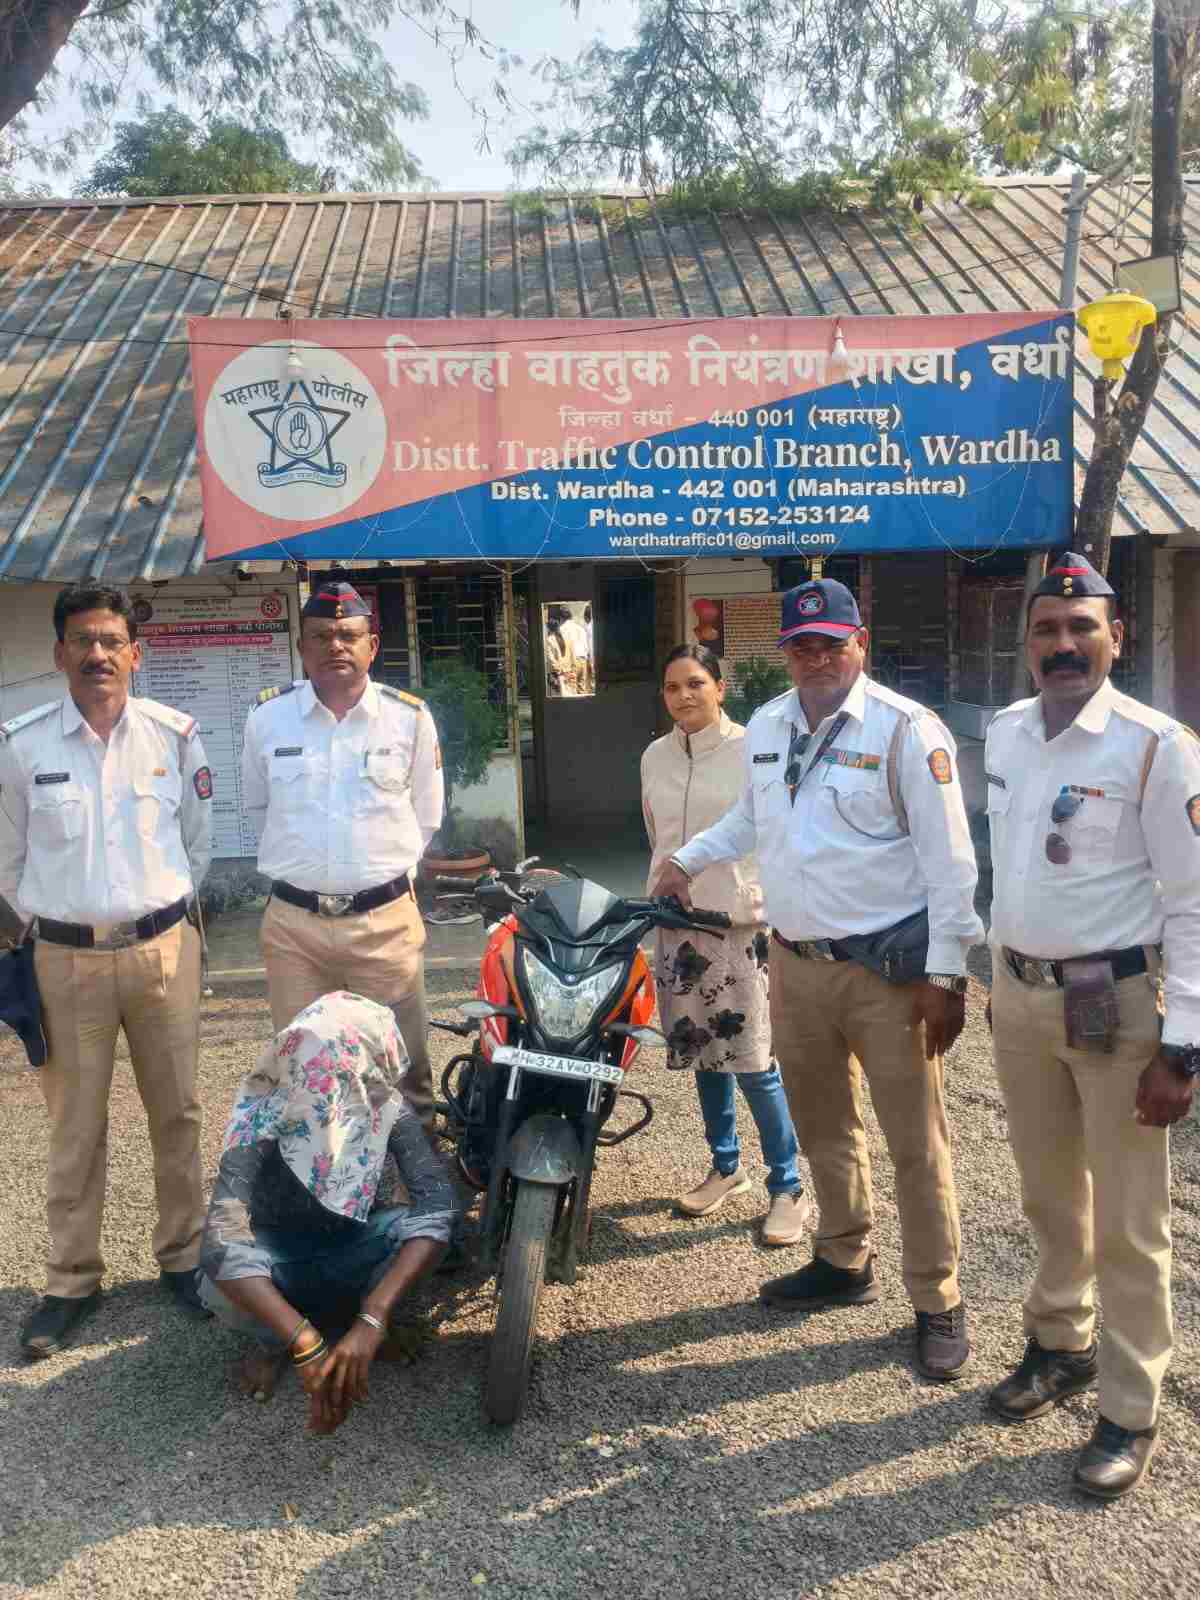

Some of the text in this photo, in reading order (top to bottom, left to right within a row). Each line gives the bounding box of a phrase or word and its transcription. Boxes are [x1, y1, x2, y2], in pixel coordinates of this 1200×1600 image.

[381, 334, 512, 392] जिल्हा
[526, 351, 670, 404] वाहतुक
[686, 334, 829, 386] नियंत्रण
[987, 326, 1072, 382] वर्धा
[312, 375, 369, 410] पोलीस
[558, 406, 623, 429] जिल्हा
[632, 401, 673, 427] वर्धा
[708, 409, 750, 428] 440
[755, 408, 795, 427] 001
[393, 429, 1061, 473] Distt. Traffic Control Branch, Wardha
[491, 481, 549, 500] Dist.
[557, 480, 654, 500] Wardha
[678, 479, 724, 498] 442
[732, 479, 779, 499] 001
[788, 477, 966, 501] (Maharashtra)
[589, 508, 668, 527] Phone
[692, 505, 870, 527] 07152-253124
[609, 533, 836, 549] wardhatraffic01@gmail.com
